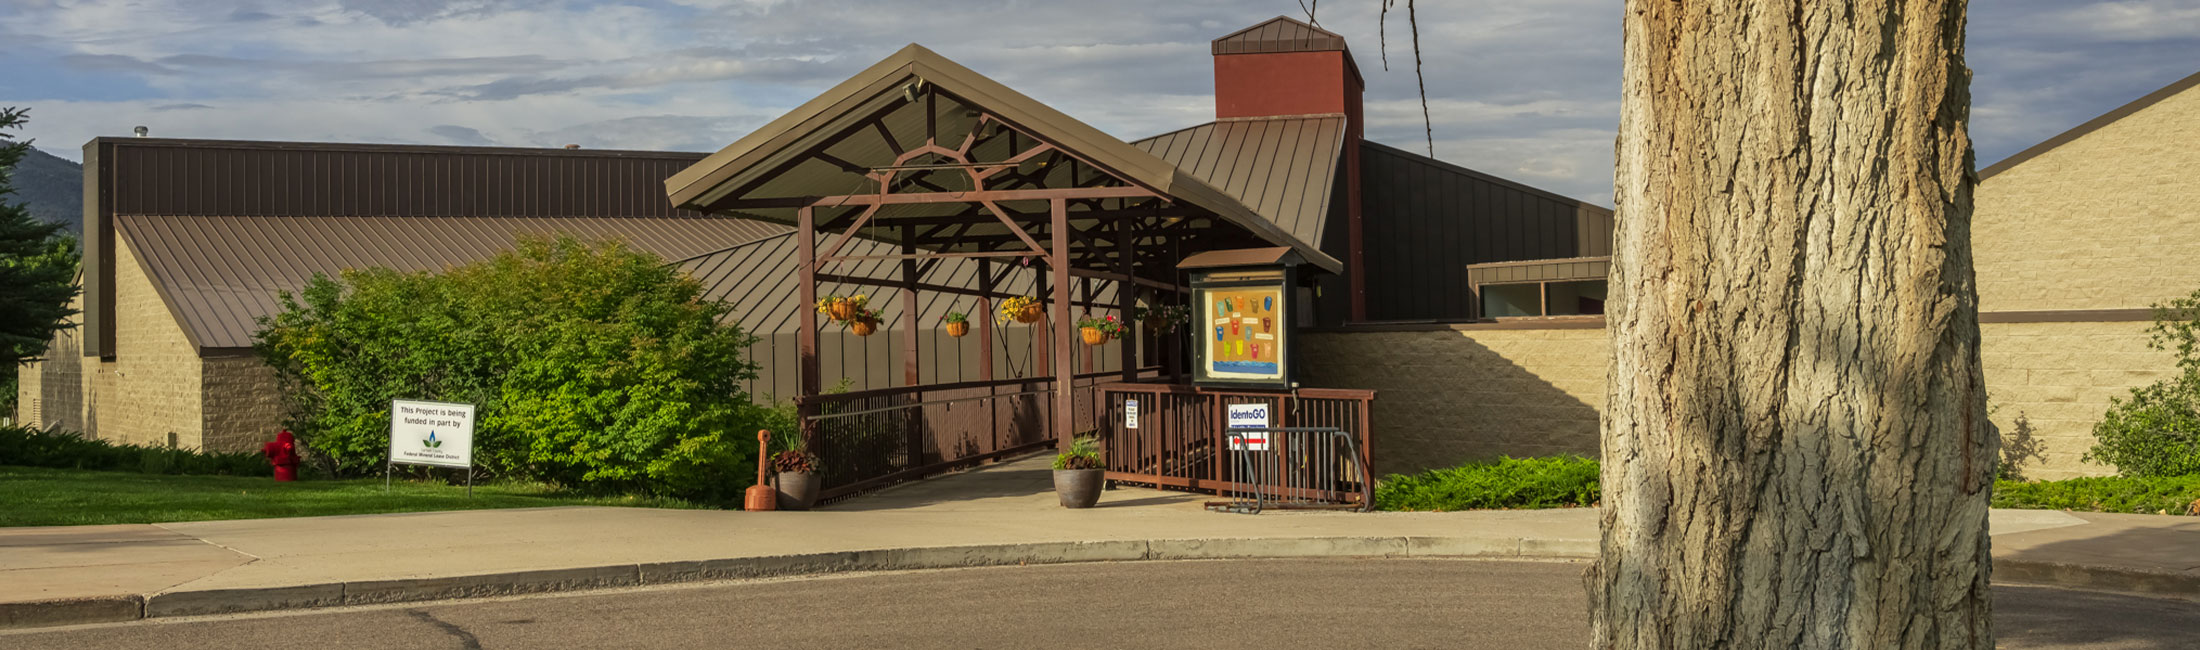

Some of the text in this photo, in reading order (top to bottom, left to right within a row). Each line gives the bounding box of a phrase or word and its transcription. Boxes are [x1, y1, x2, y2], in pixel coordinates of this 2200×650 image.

[401, 406, 413, 414] This
[415, 407, 438, 416] Project
[448, 409, 466, 418] being
[1231, 408, 1266, 419] IdentoGO
[405, 417, 427, 425] funded
[437, 419, 451, 427] part
[453, 420, 461, 428] by
